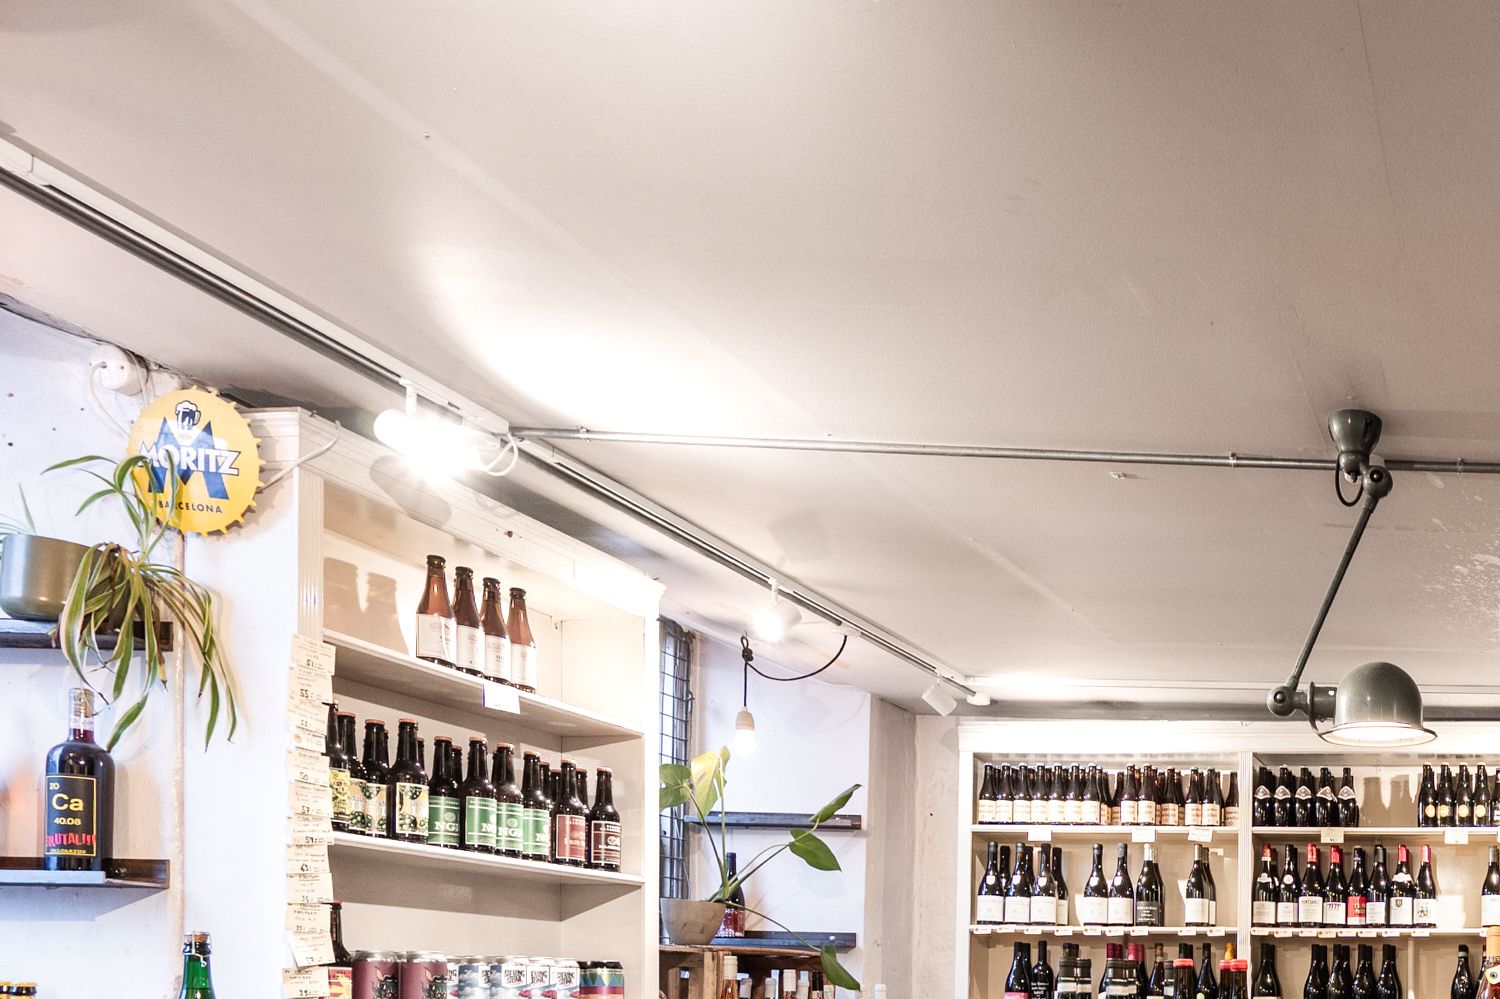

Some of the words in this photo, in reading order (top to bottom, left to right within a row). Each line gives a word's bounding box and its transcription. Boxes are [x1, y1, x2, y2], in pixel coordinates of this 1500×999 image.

[139, 441, 242, 476] MORITZ
[158, 500, 223, 514] BACELONA
[52, 793, 83, 811] Ca
[54, 817, 81, 826] 40.08
